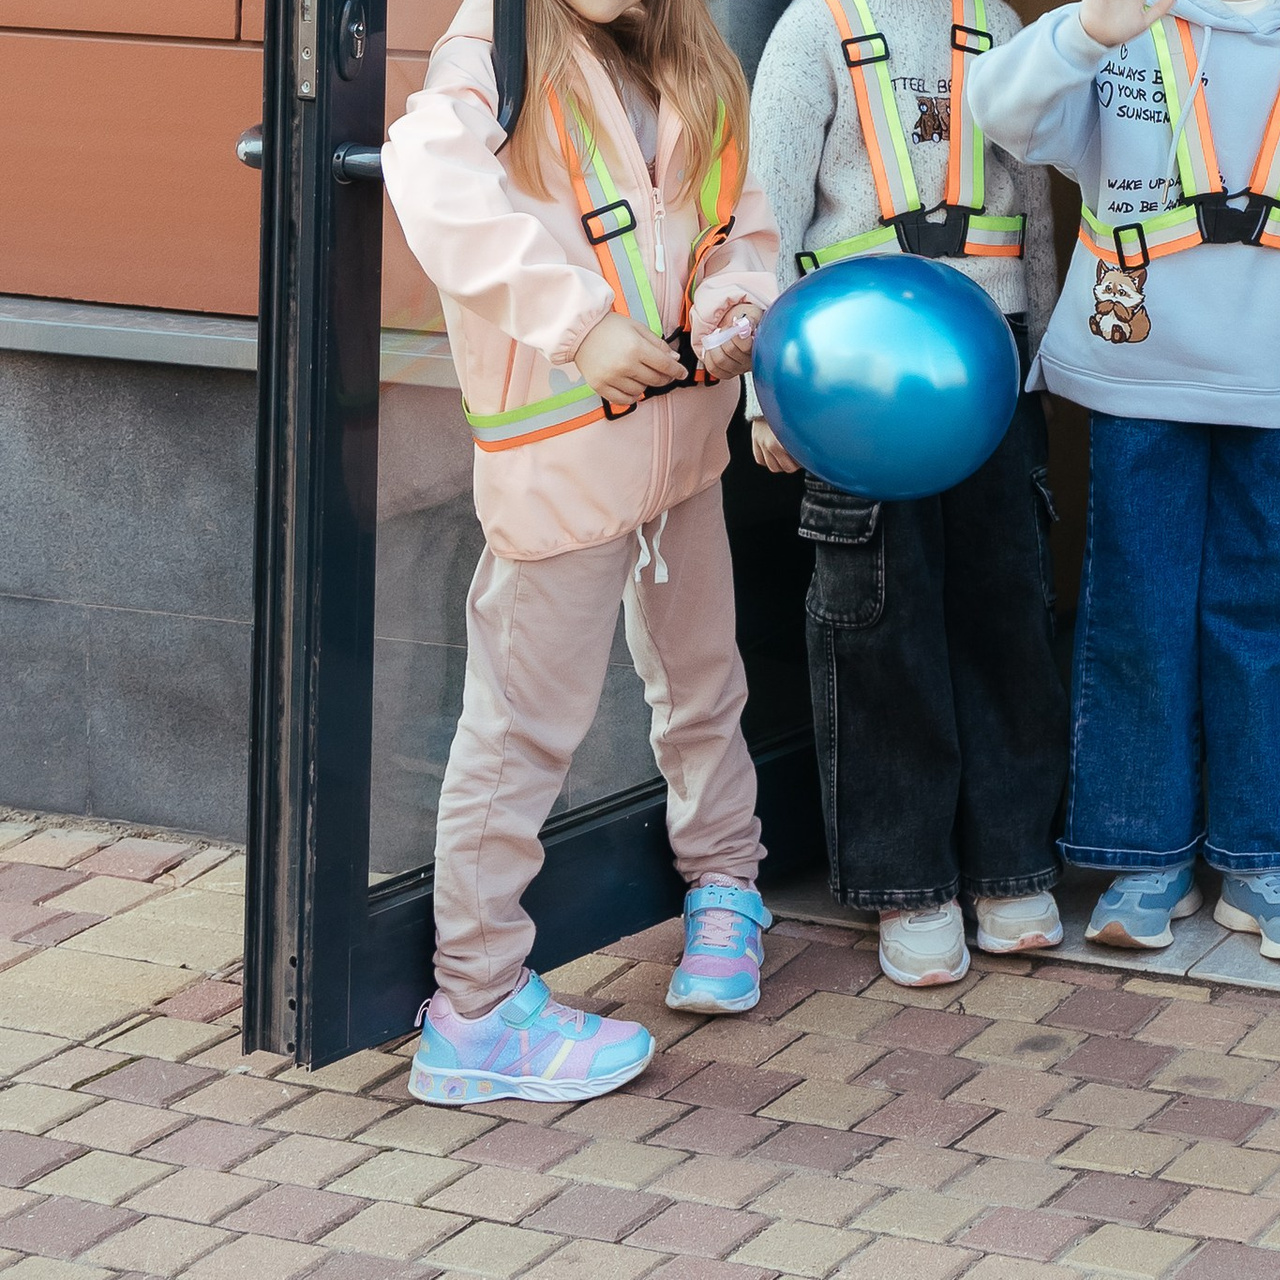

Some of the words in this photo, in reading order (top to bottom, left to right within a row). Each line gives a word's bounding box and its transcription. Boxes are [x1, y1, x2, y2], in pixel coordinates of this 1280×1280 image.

[1100, 60, 1147, 82] ALWAYS
[1151, 69, 1164, 85] B
[890, 76, 931, 93] TTER
[1117, 83, 1148, 102] YOUR
[1116, 104, 1171, 124] SUNSHIN
[1107, 178, 1143, 191] WAKE
[1148, 178, 1166, 190] UP
[1107, 200, 1134, 214] AND
[1139, 200, 1159, 213] BE
